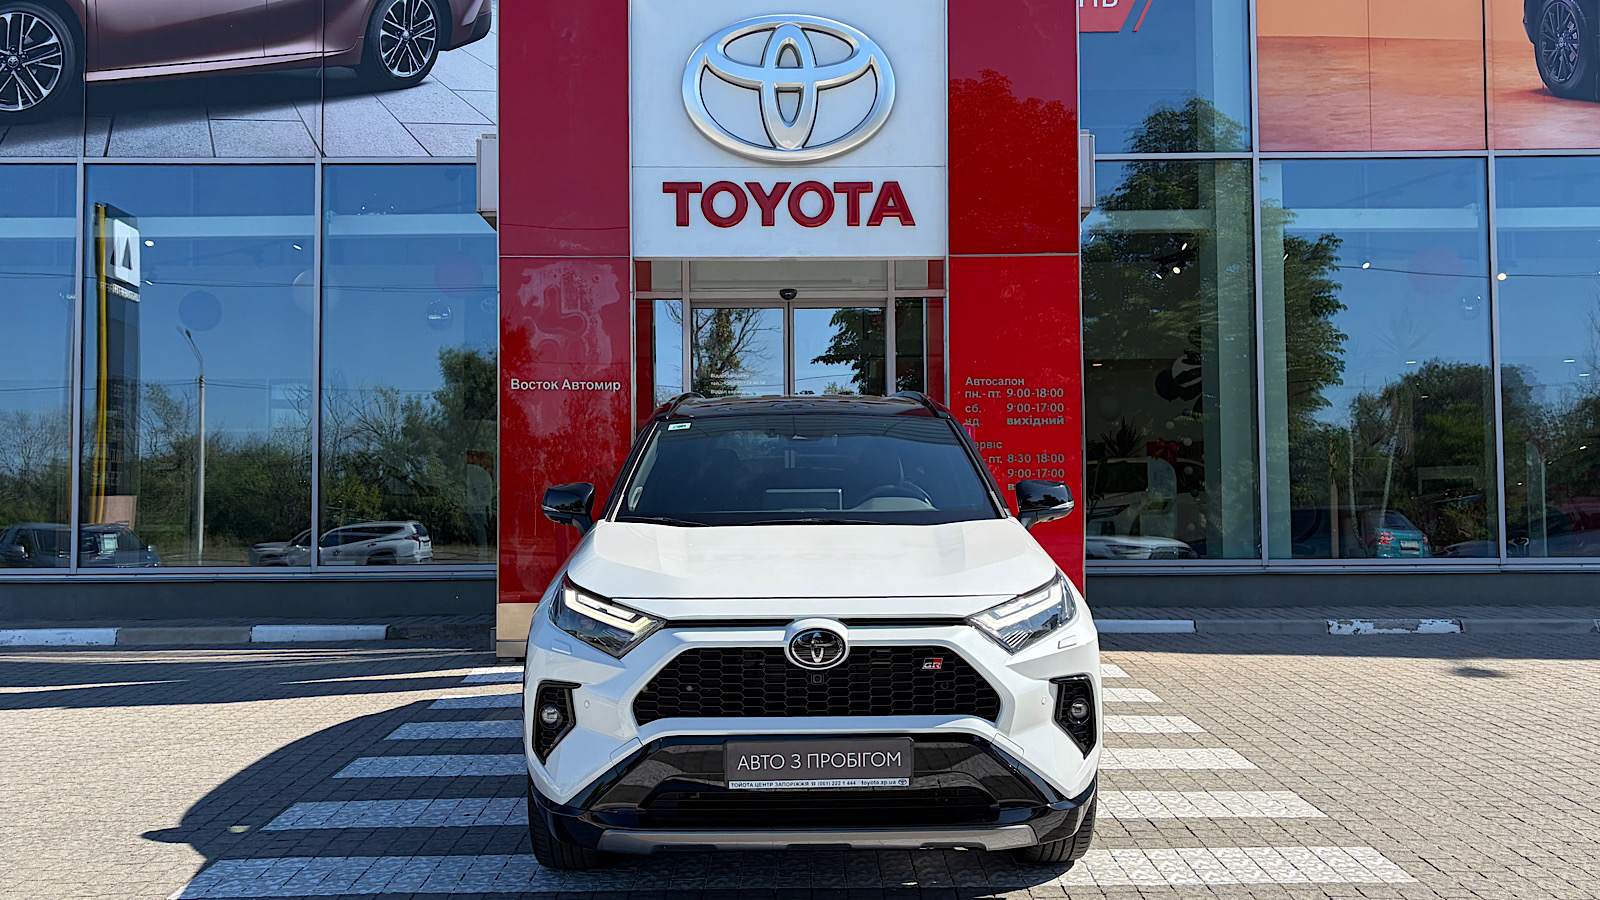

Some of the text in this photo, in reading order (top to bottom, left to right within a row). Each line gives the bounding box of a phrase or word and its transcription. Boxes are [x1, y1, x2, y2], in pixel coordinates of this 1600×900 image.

[663, 181, 916, 228] TOYOTA
[511, 379, 621, 392] Восток Автомир
[965, 376, 1025, 386] Автосалон
[965, 404, 982, 413] сб.
[1006, 415, 1064, 426] вихідний
[973, 441, 1003, 451] ервіс
[1007, 454, 1031, 463] 8:30
[1036, 454, 1065, 463] 18:00
[1007, 468, 1065, 478] 9:00-17:00
[737, 754, 785, 771] АВТО
[807, 752, 901, 769] ПРОБІГОМ
